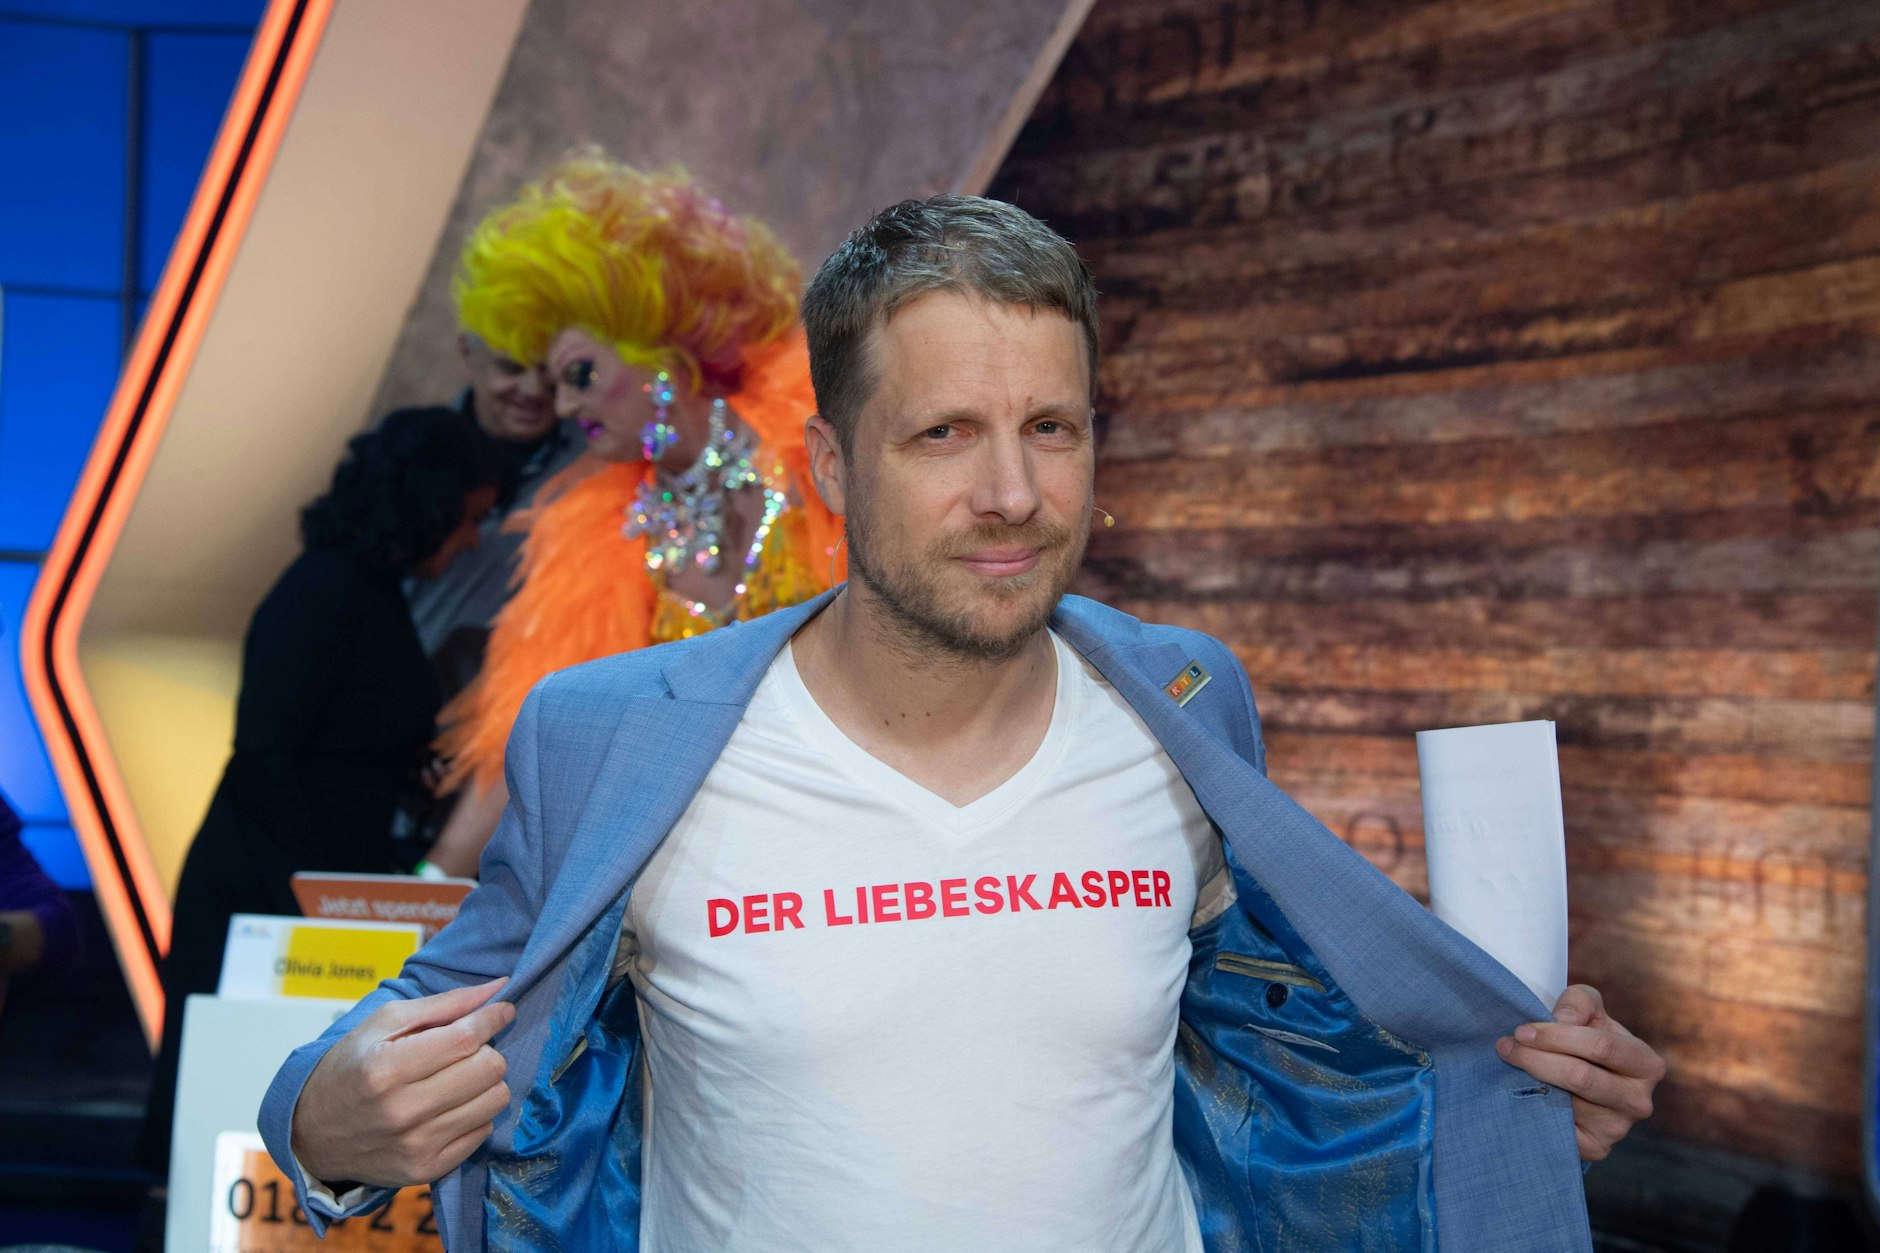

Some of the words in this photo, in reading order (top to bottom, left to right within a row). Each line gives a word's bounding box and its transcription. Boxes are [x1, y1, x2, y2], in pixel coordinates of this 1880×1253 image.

[707, 892, 805, 937] DER
[824, 870, 1171, 927] LIEBESKASPER
[275, 957, 323, 978] Olivia
[328, 960, 375, 981] Jones
